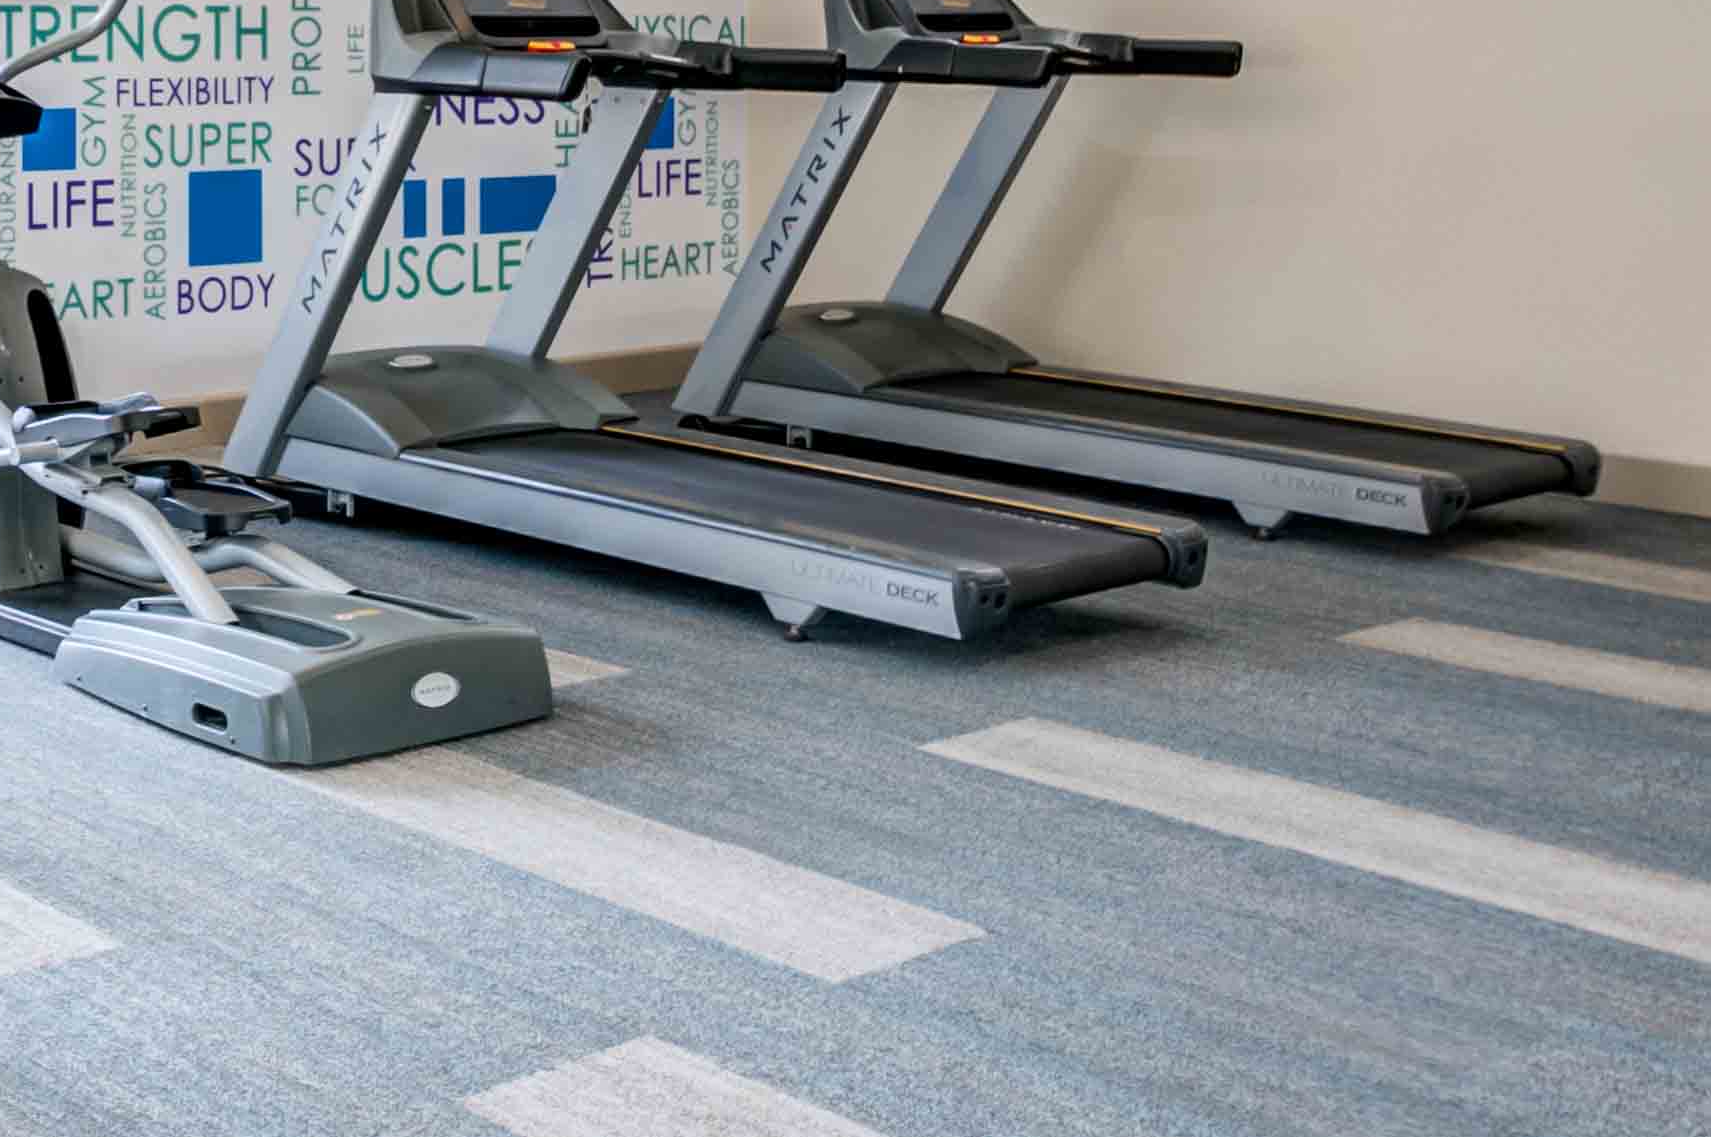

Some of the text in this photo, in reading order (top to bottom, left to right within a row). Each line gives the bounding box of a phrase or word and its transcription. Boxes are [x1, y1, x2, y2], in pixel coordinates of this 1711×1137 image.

[347, 24, 365, 74] LIFE
[116, 75, 274, 108] FLEXIBILITY
[80, 76, 107, 168] GYM
[144, 121, 272, 167] SUPER
[119, 114, 136, 238] NUTRITION
[638, 159, 701, 198] LIFE
[760, 104, 851, 273] MATRIX
[28, 179, 114, 230] LIFE
[302, 120, 387, 314] MATRIX
[721, 159, 739, 276] AEROBICS
[144, 182, 167, 320] AEROBICS
[622, 240, 715, 280] HEART
[178, 273, 275, 314] BODY
[1355, 487, 1407, 508] DECK
[886, 582, 939, 608] DECK
